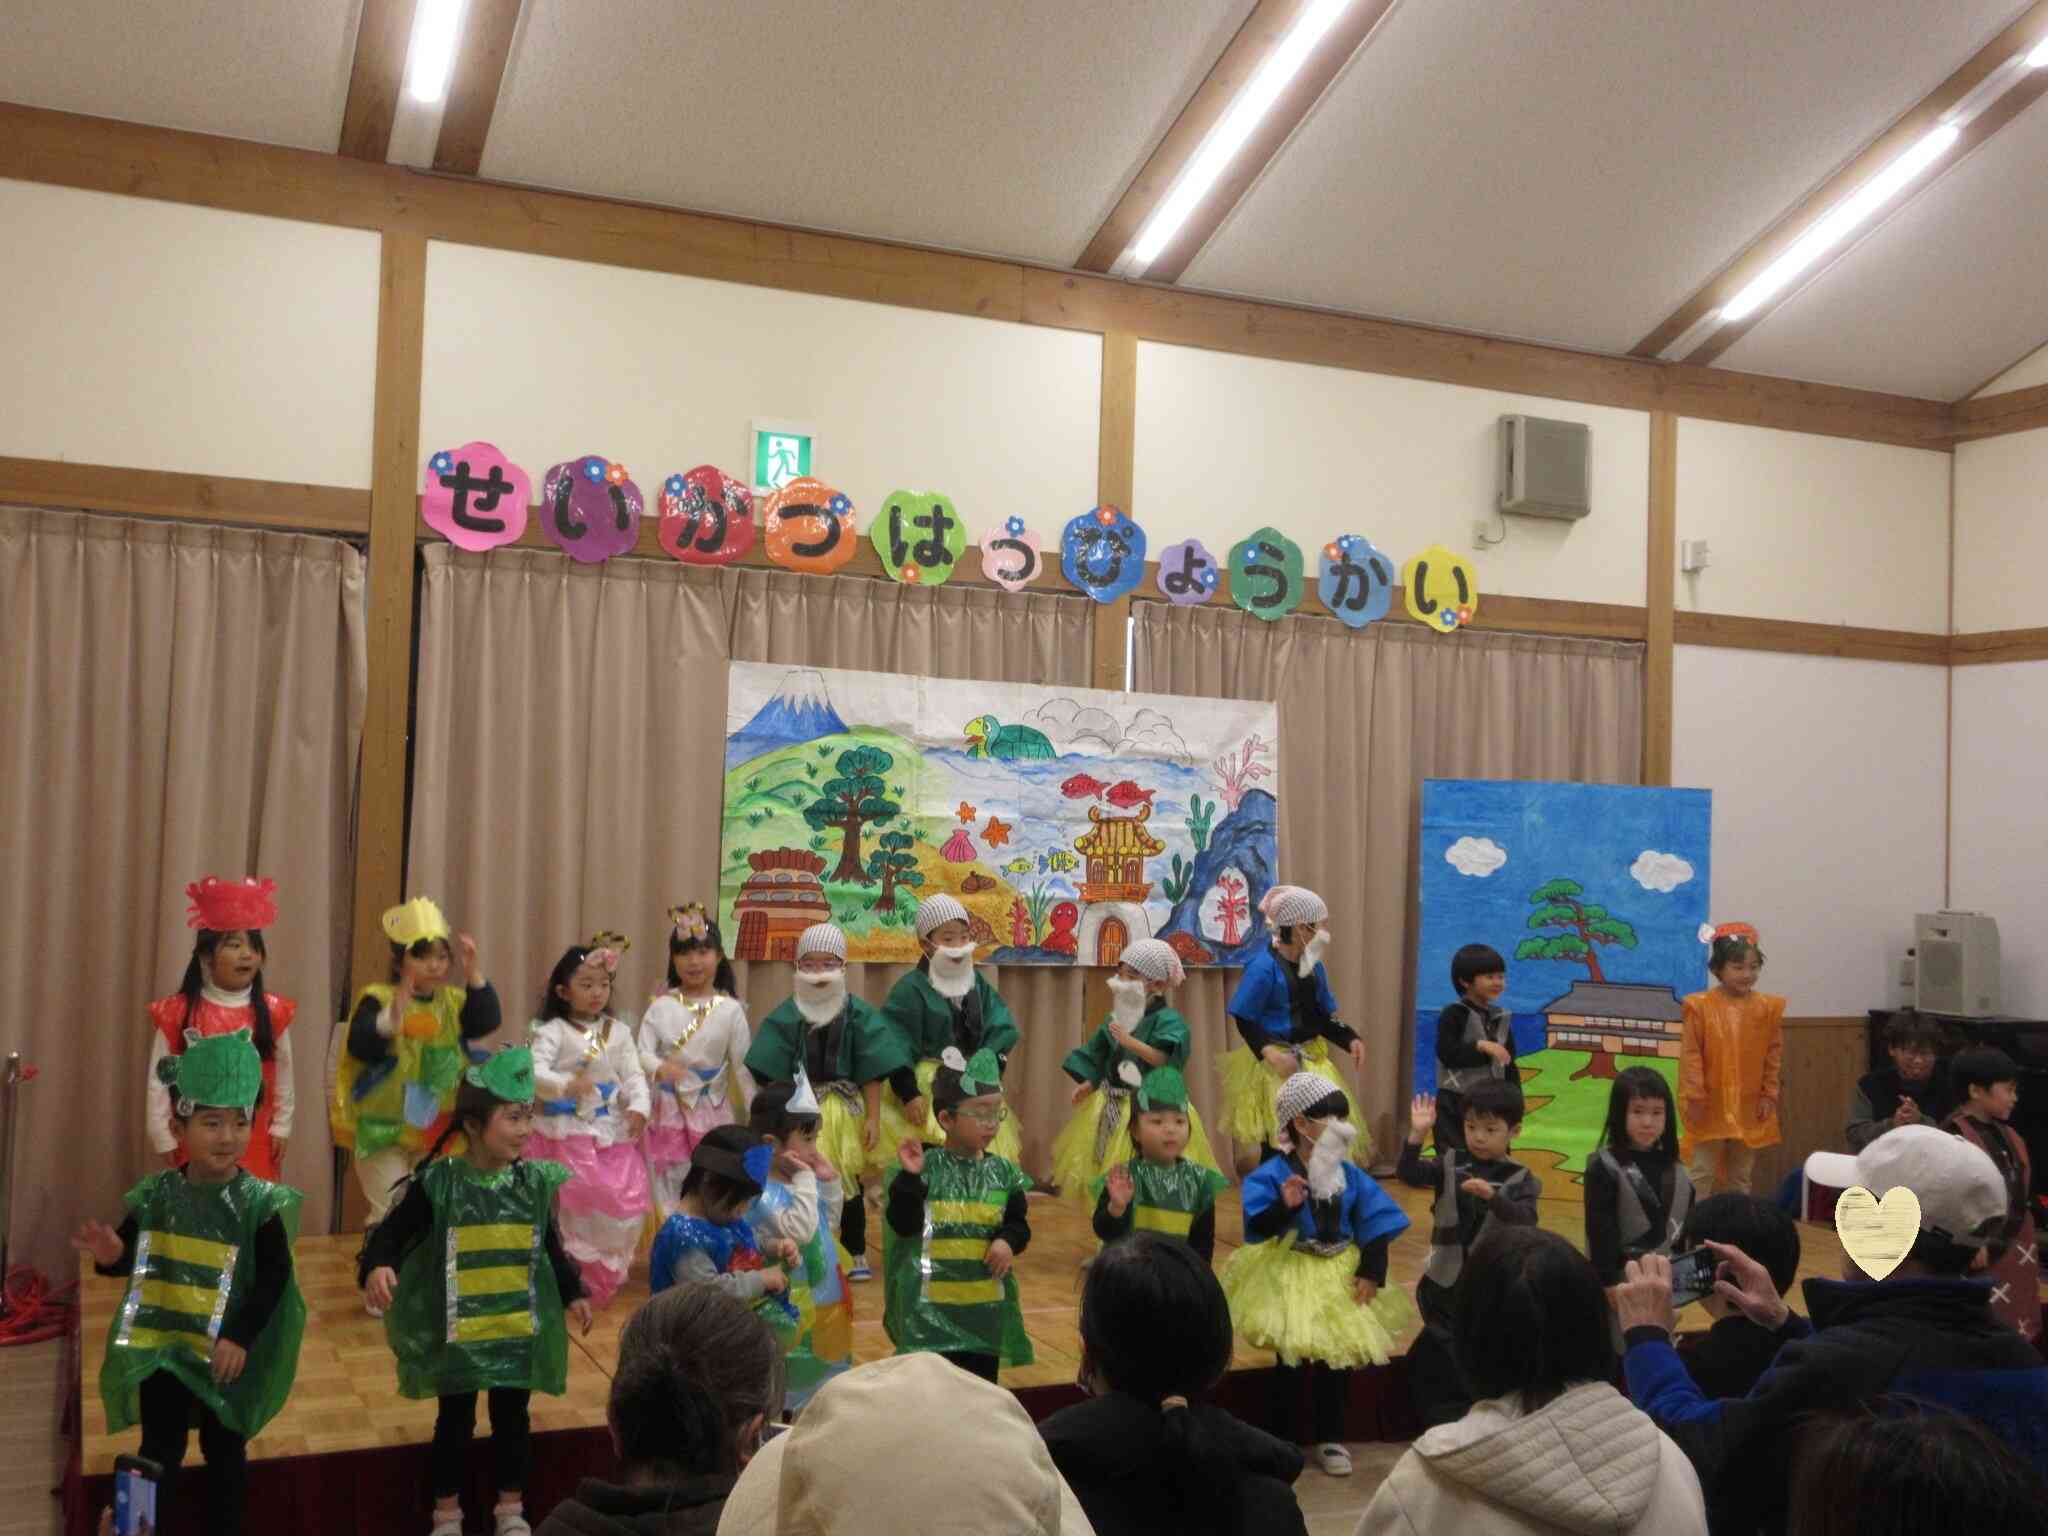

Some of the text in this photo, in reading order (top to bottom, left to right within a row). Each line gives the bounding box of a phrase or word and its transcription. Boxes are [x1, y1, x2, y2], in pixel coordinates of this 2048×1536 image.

[438, 460, 1470, 615] せいかつはっぴょうかい
